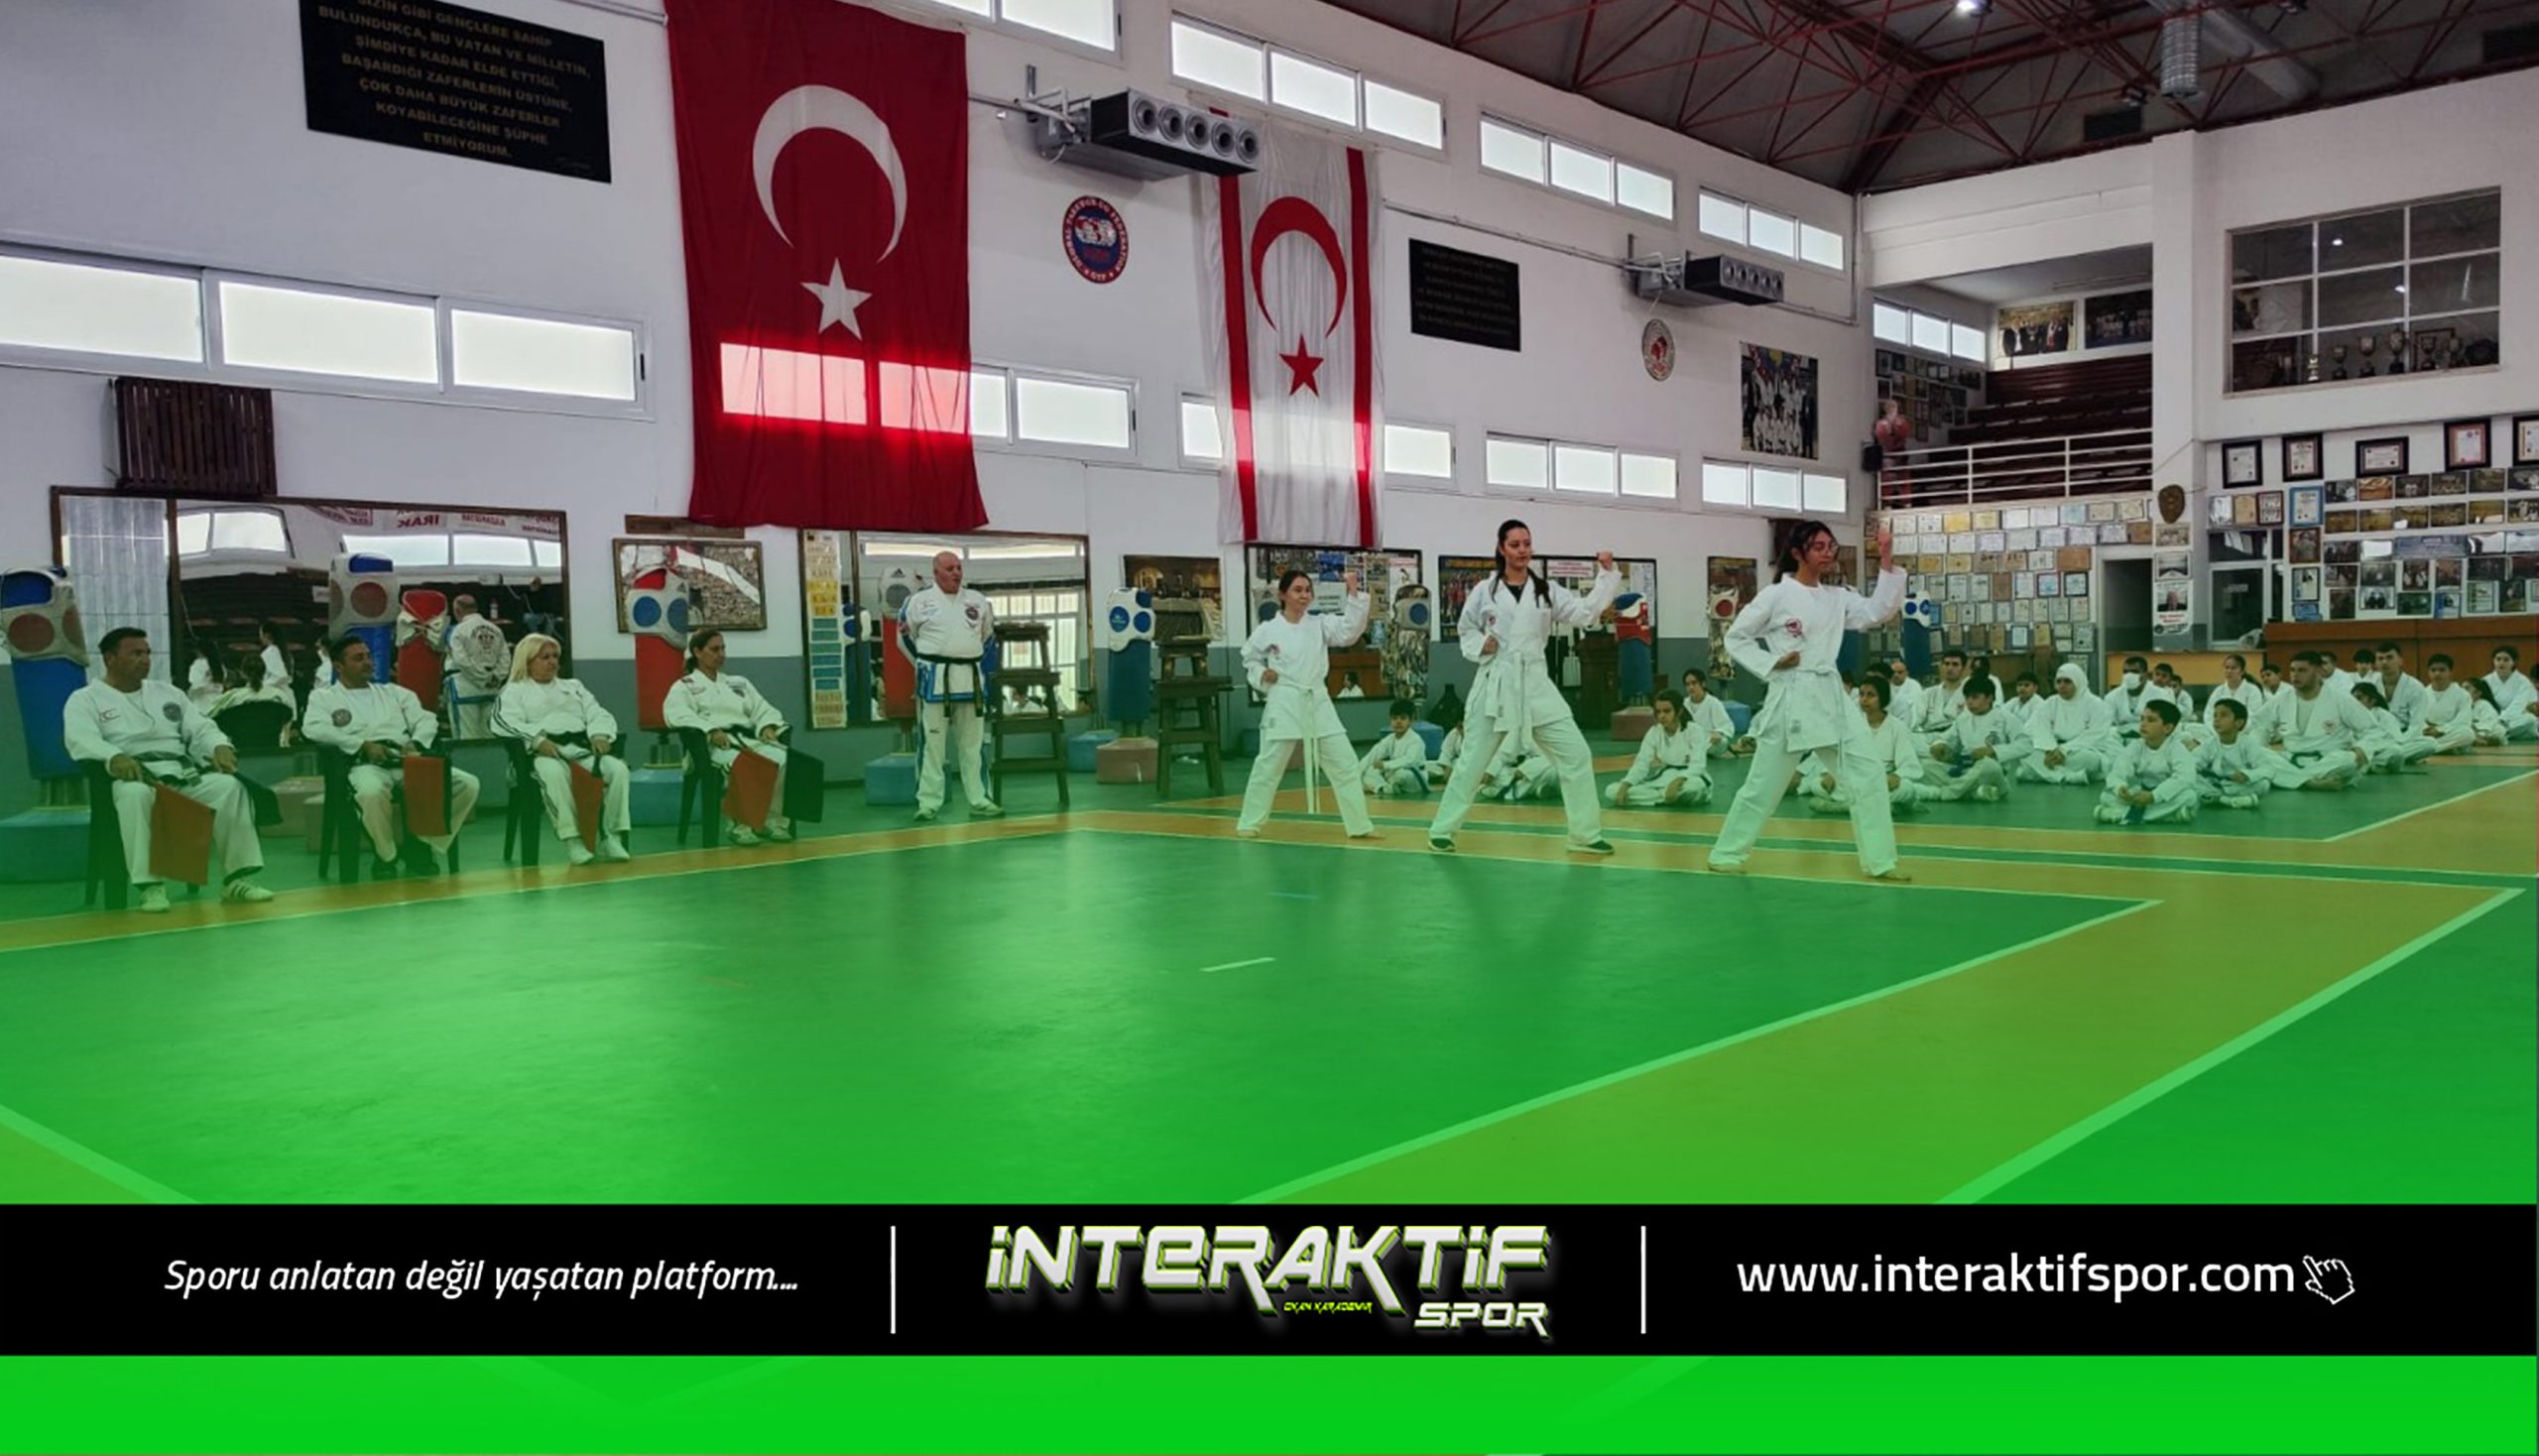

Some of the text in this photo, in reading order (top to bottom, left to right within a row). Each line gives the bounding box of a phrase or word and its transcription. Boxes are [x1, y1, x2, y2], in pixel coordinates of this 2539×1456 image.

[435, 12, 511, 39] GENÇLERE
[429, 31, 451, 46] BU
[453, 36, 503, 58] VATAN
[506, 49, 524, 63] VE
[419, 49, 470, 70] KADAR
[473, 60, 509, 78] ELDE
[358, 76, 561, 128] ÇOK DAHA BÜYÜK ZAFERLER
[503, 126, 548, 147] ŞÜPHE
